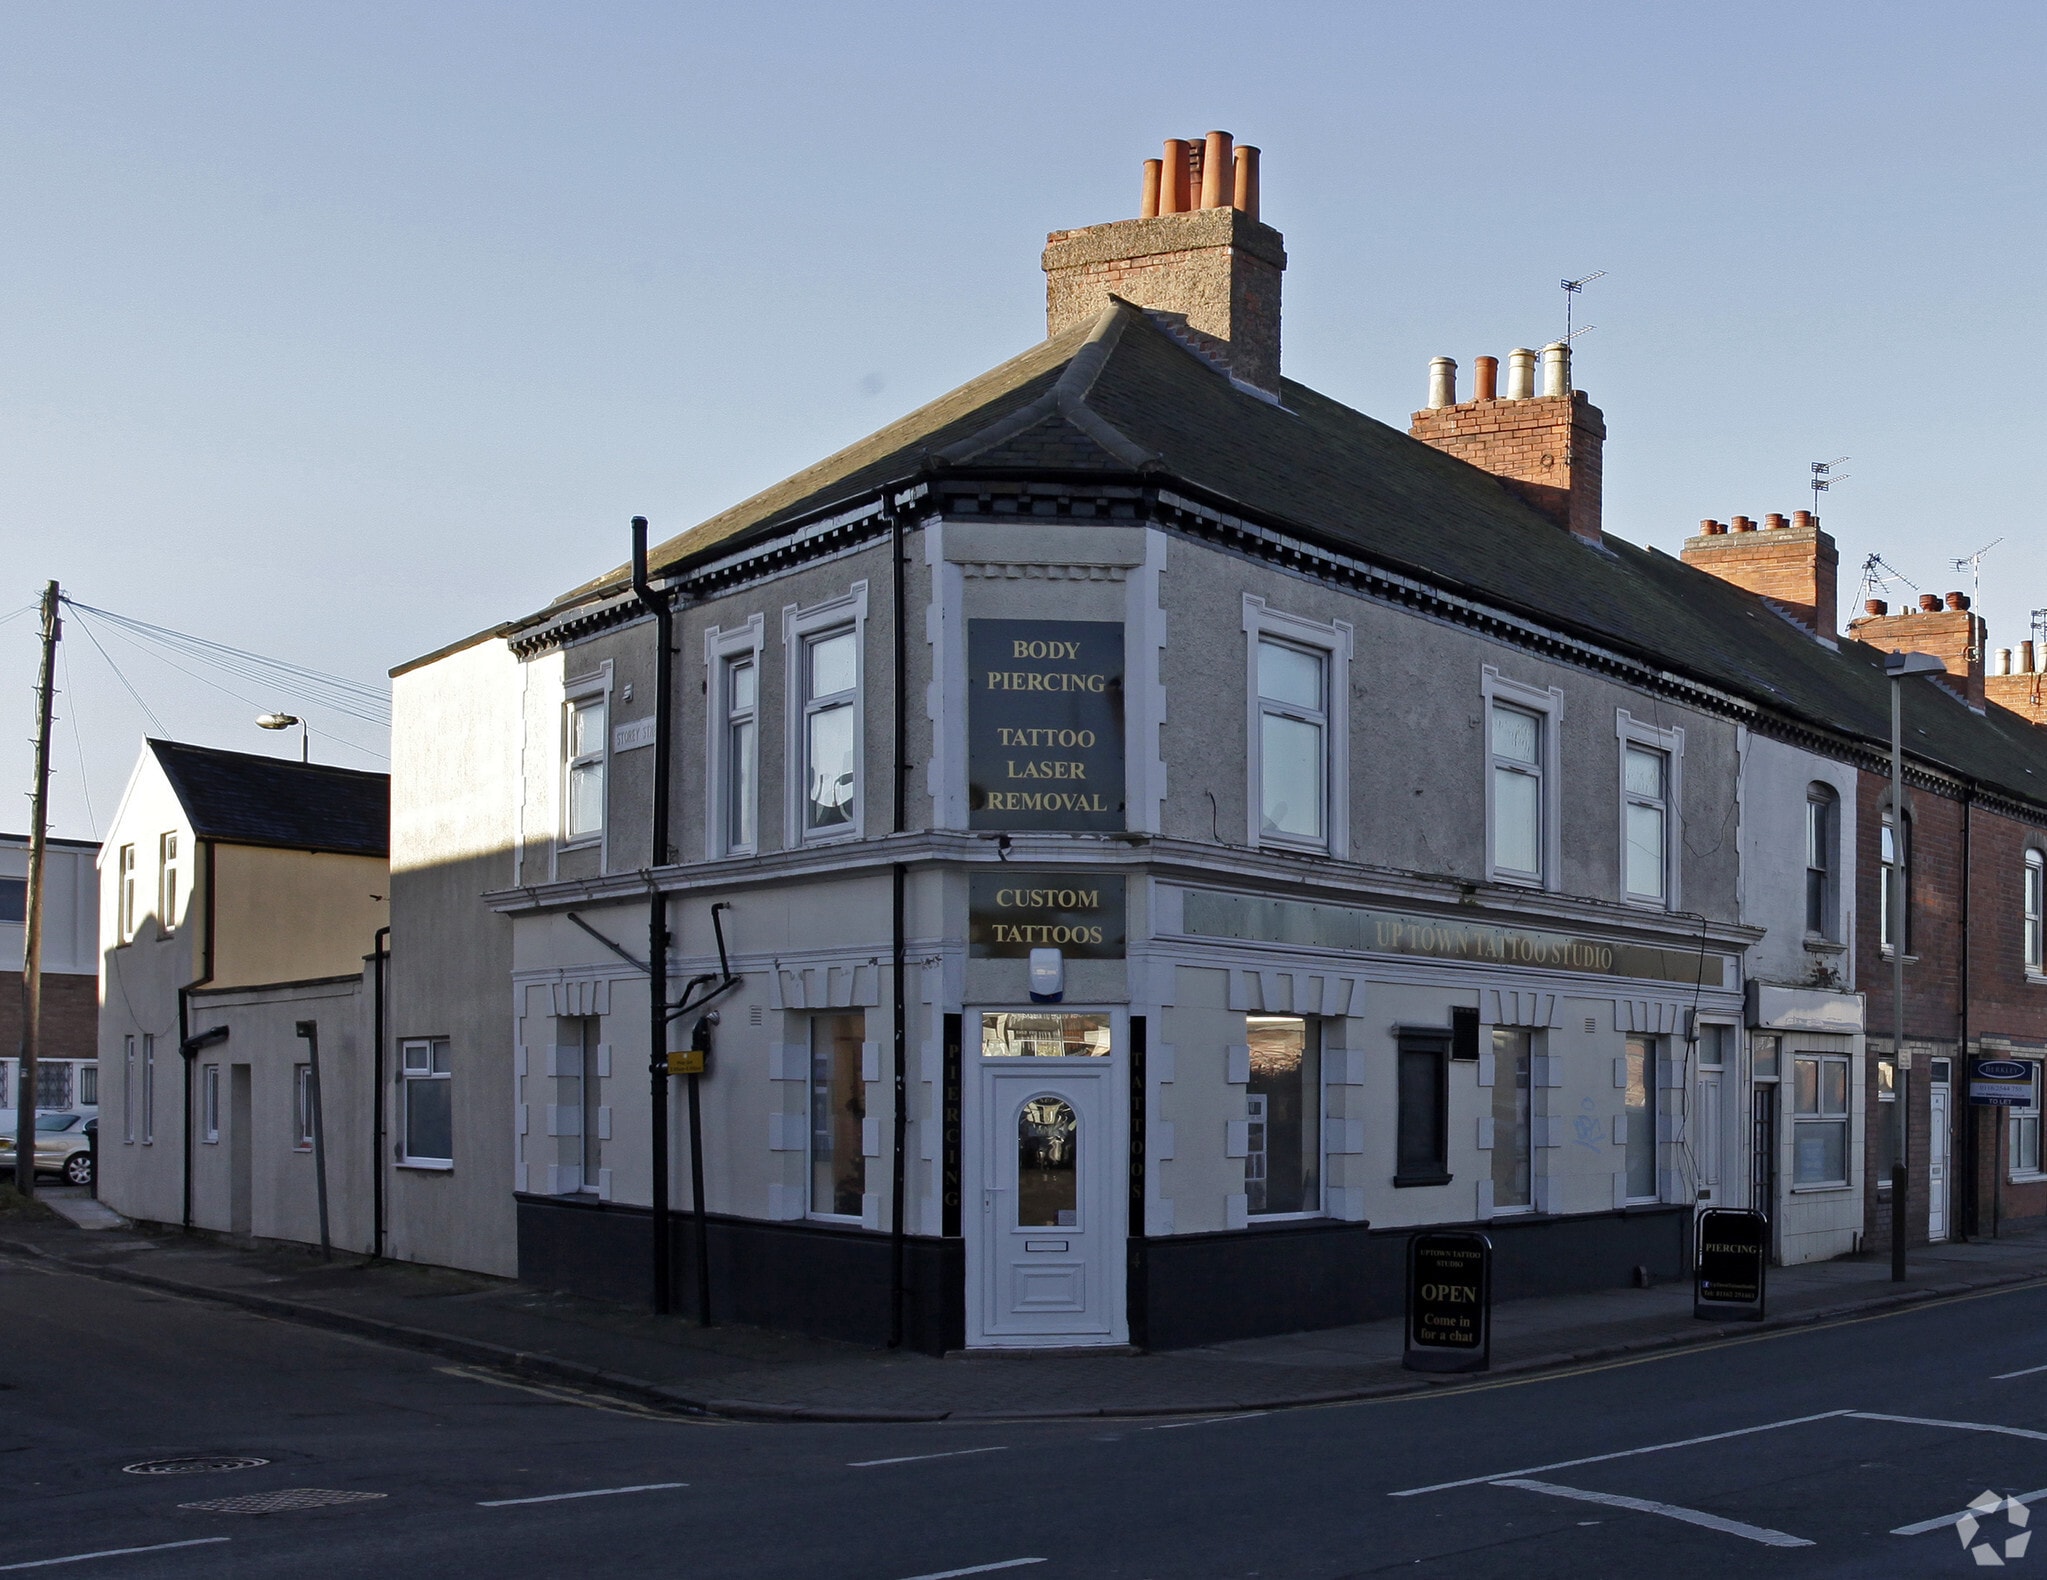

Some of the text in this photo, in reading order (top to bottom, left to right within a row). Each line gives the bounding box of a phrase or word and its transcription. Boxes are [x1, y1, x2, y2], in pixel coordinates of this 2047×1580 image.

[1012, 640, 1081, 660] BODY
[987, 671, 1106, 693] PIERCING
[997, 728, 1096, 748] TATTOO
[1007, 760, 1086, 780] LASER
[987, 791, 1108, 812] REMOVAL
[995, 888, 1099, 908] CUSTOM
[992, 924, 1103, 945] TATTOOS
[1474, 932, 1547, 963] TATTOO
[1551, 943, 1613, 970] STUDIO
[945, 1044, 959, 1207] PIERCING
[1131, 1052, 1143, 1199] TATTOOS
[1420, 1249, 1481, 1259] UPTOWN TATTOO
[1705, 1243, 1757, 1254] PIERCING
[1436, 1260, 1463, 1268] STUDIO
[1421, 1283, 1477, 1303] OPEN
[1424, 1313, 1470, 1328] Come in
[1421, 1328, 1473, 1342] for a chat
